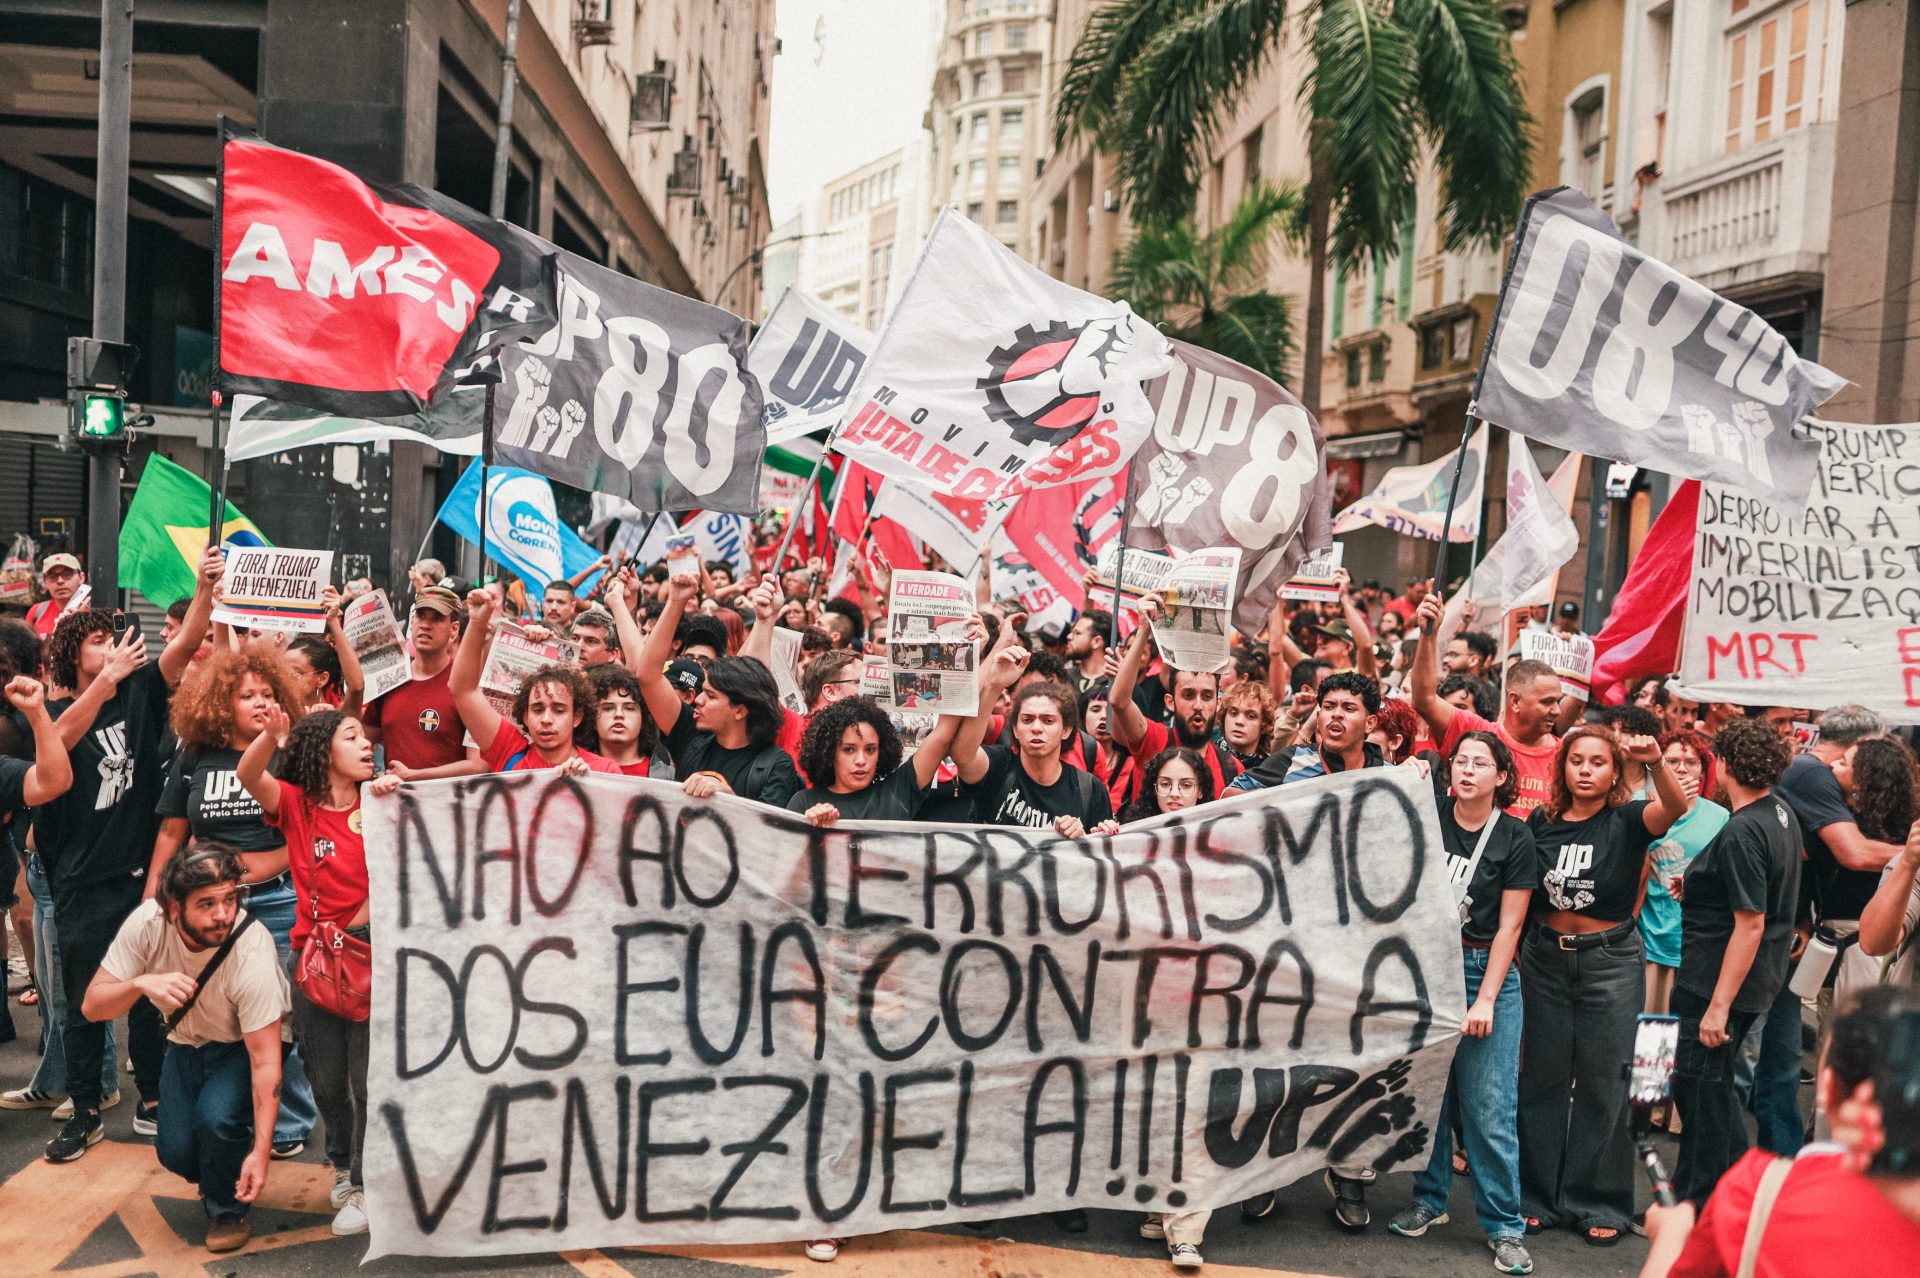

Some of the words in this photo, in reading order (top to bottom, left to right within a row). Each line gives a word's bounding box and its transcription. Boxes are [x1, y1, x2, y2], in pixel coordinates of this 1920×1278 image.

[222, 222, 476, 333] AMES
[769, 317, 867, 409] UP
[594, 317, 746, 497] 80
[841, 400, 924, 463] LUTA
[916, 442, 970, 484] DE
[1154, 353, 1256, 456] UP
[1220, 404, 1318, 550] 8
[1817, 459, 1920, 500] ÉRIC
[1704, 489, 1857, 543] DERROAR
[1867, 506, 1899, 539] A
[234, 554, 269, 574] FORA
[272, 555, 320, 577] TRUMP
[1121, 570, 1164, 591] ENEZUEL
[1137, 556, 1173, 577] TRUMP
[1300, 563, 1331, 578] NEZUELA
[231, 576, 248, 595] DA
[251, 577, 317, 600] VENEZUELA
[898, 583, 905, 594] A
[907, 584, 950, 598] VERDADE
[509, 636, 548, 656] VERDADE
[1532, 635, 1558, 651] FORA
[1707, 631, 1818, 680] MRT
[204, 770, 242, 801] UP
[1520, 777, 1544, 792] LUTA
[200, 803, 219, 811] Pelo
[210, 810, 230, 818] Pelo
[397, 774, 595, 928] NÃO
[619, 793, 740, 911] AO
[761, 778, 1428, 941] TERRORISMO
[1555, 843, 1594, 878] UP
[397, 937, 589, 1080] DOS
[612, 918, 827, 1067] EUA
[858, 932, 1315, 1062] CONTRA
[1350, 937, 1433, 1055] A
[1204, 1064, 1360, 1168] UP
